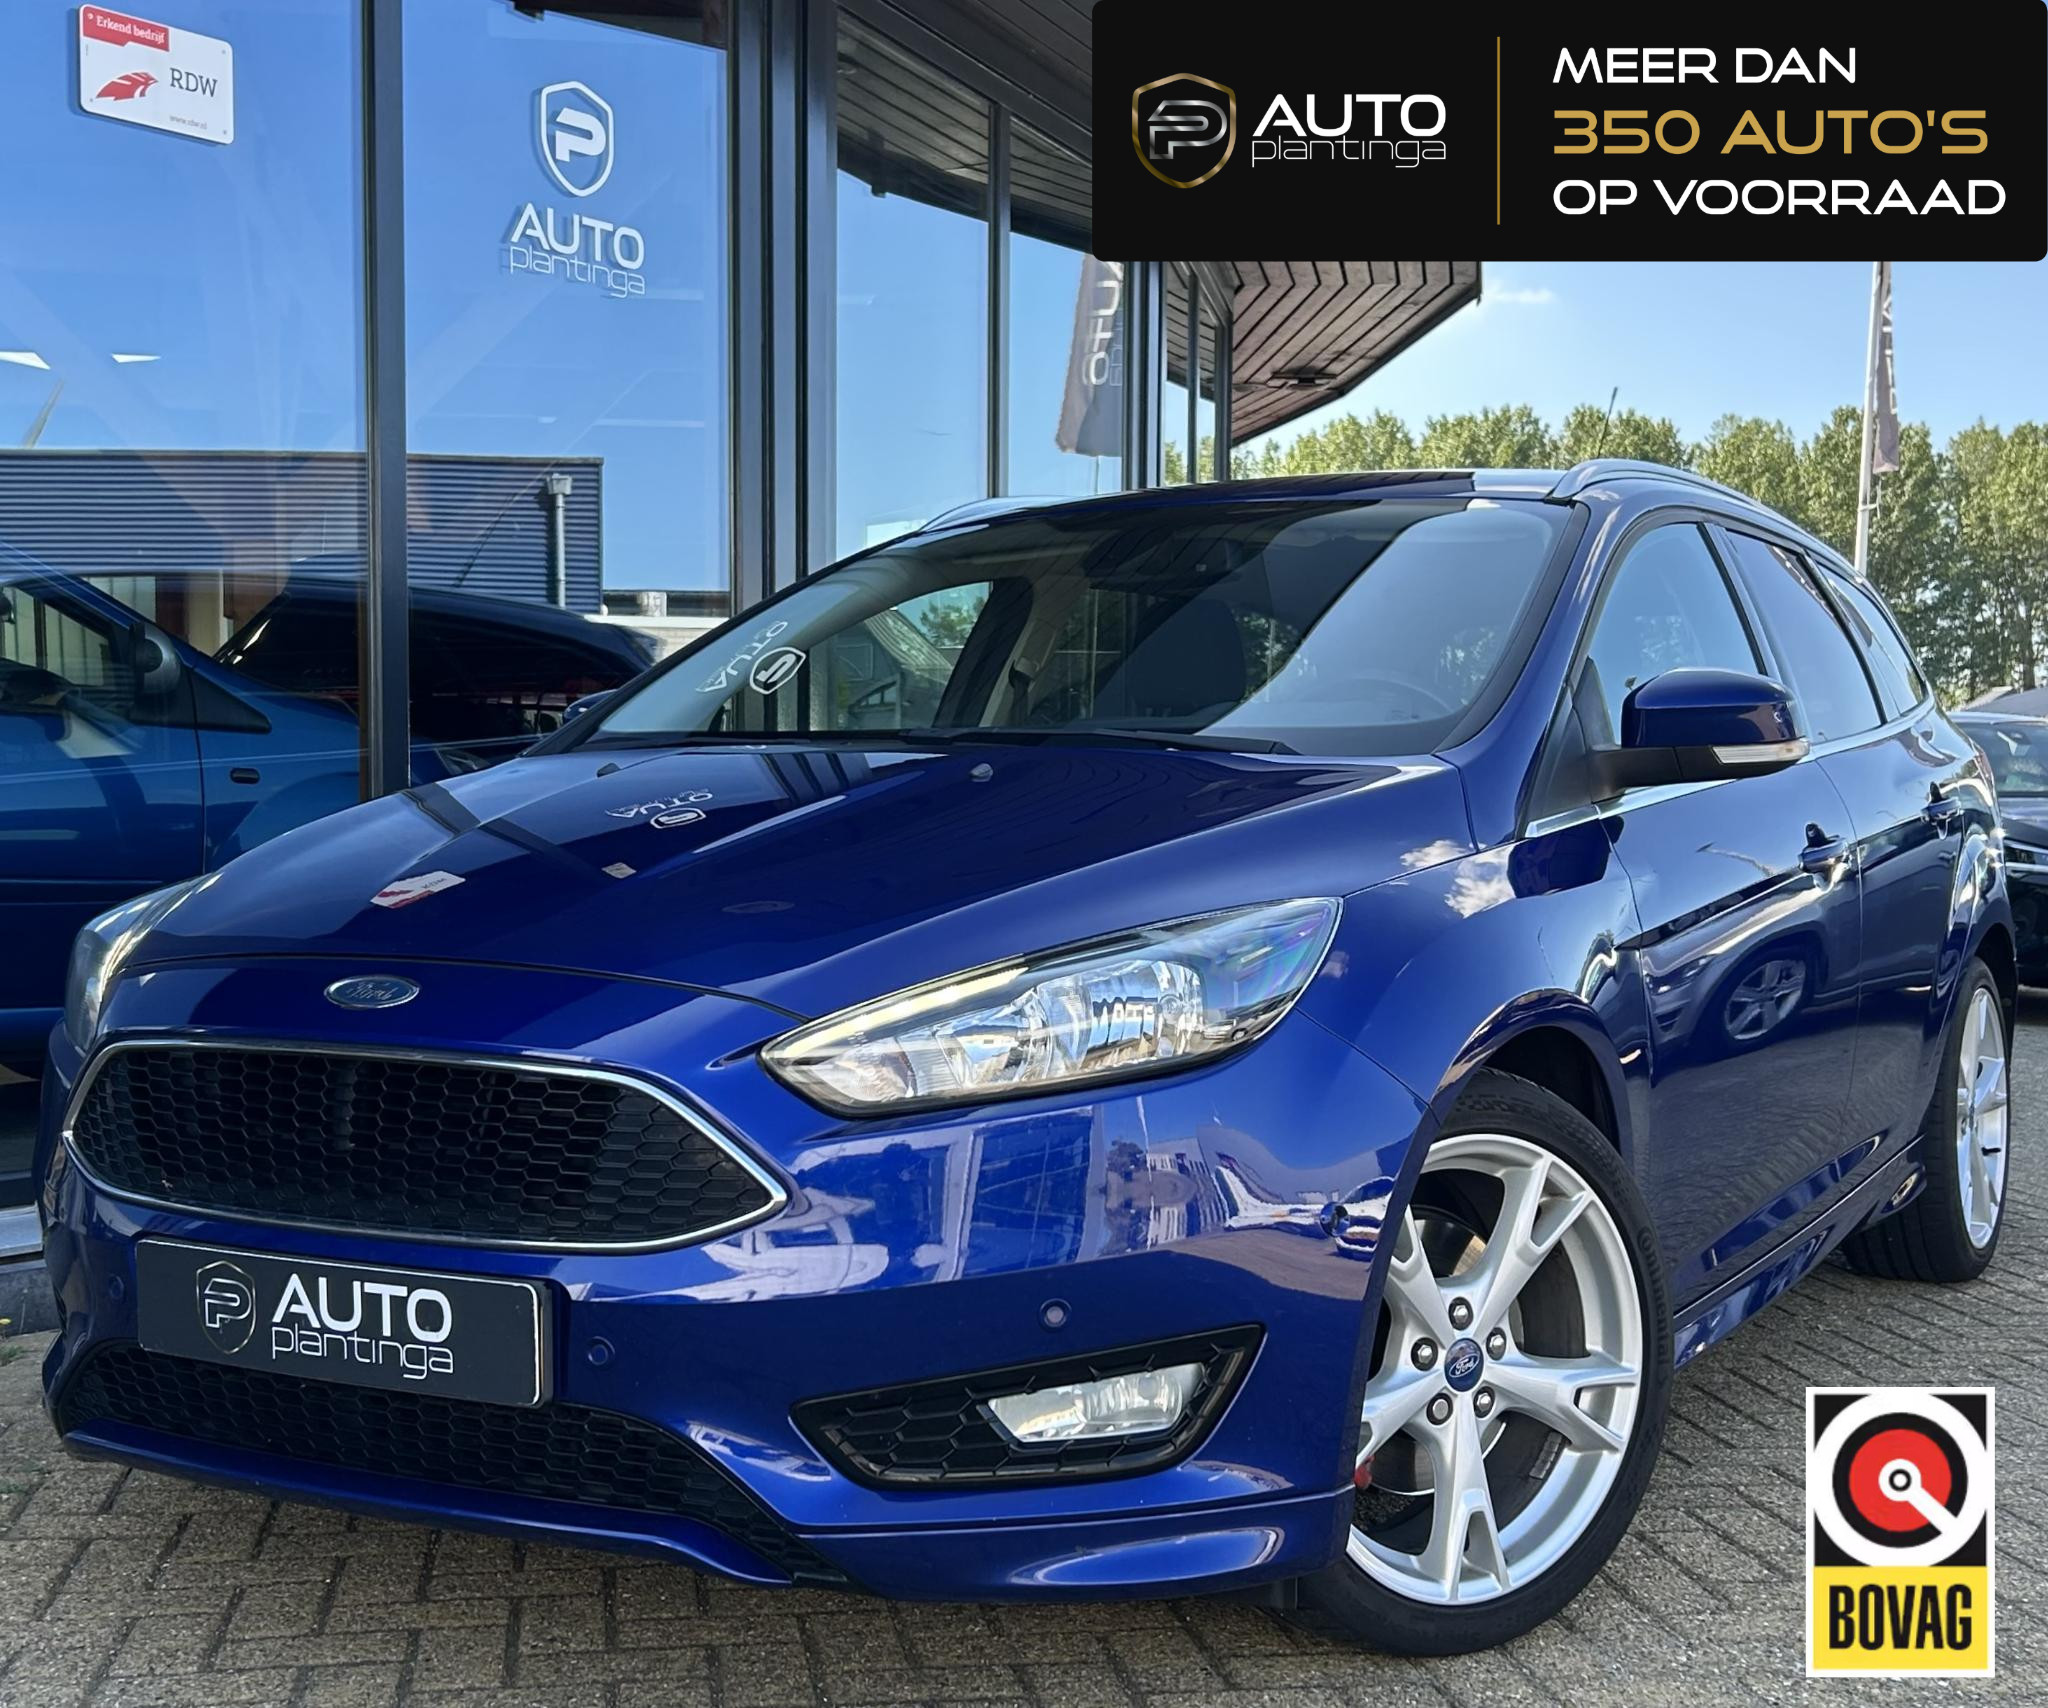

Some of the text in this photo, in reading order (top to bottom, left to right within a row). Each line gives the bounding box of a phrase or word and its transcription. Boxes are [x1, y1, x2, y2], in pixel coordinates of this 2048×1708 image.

[96, 15, 165, 45] Erkend bedrijf
[169, 67, 218, 98] RDW
[511, 202, 645, 270] AUTO
[510, 245, 645, 299] plantinga
[345, 982, 400, 1001] Ford
[272, 1273, 453, 1342] AUTO
[272, 1324, 453, 1380] plantinga
[1455, 1357, 1475, 1375] Ford
